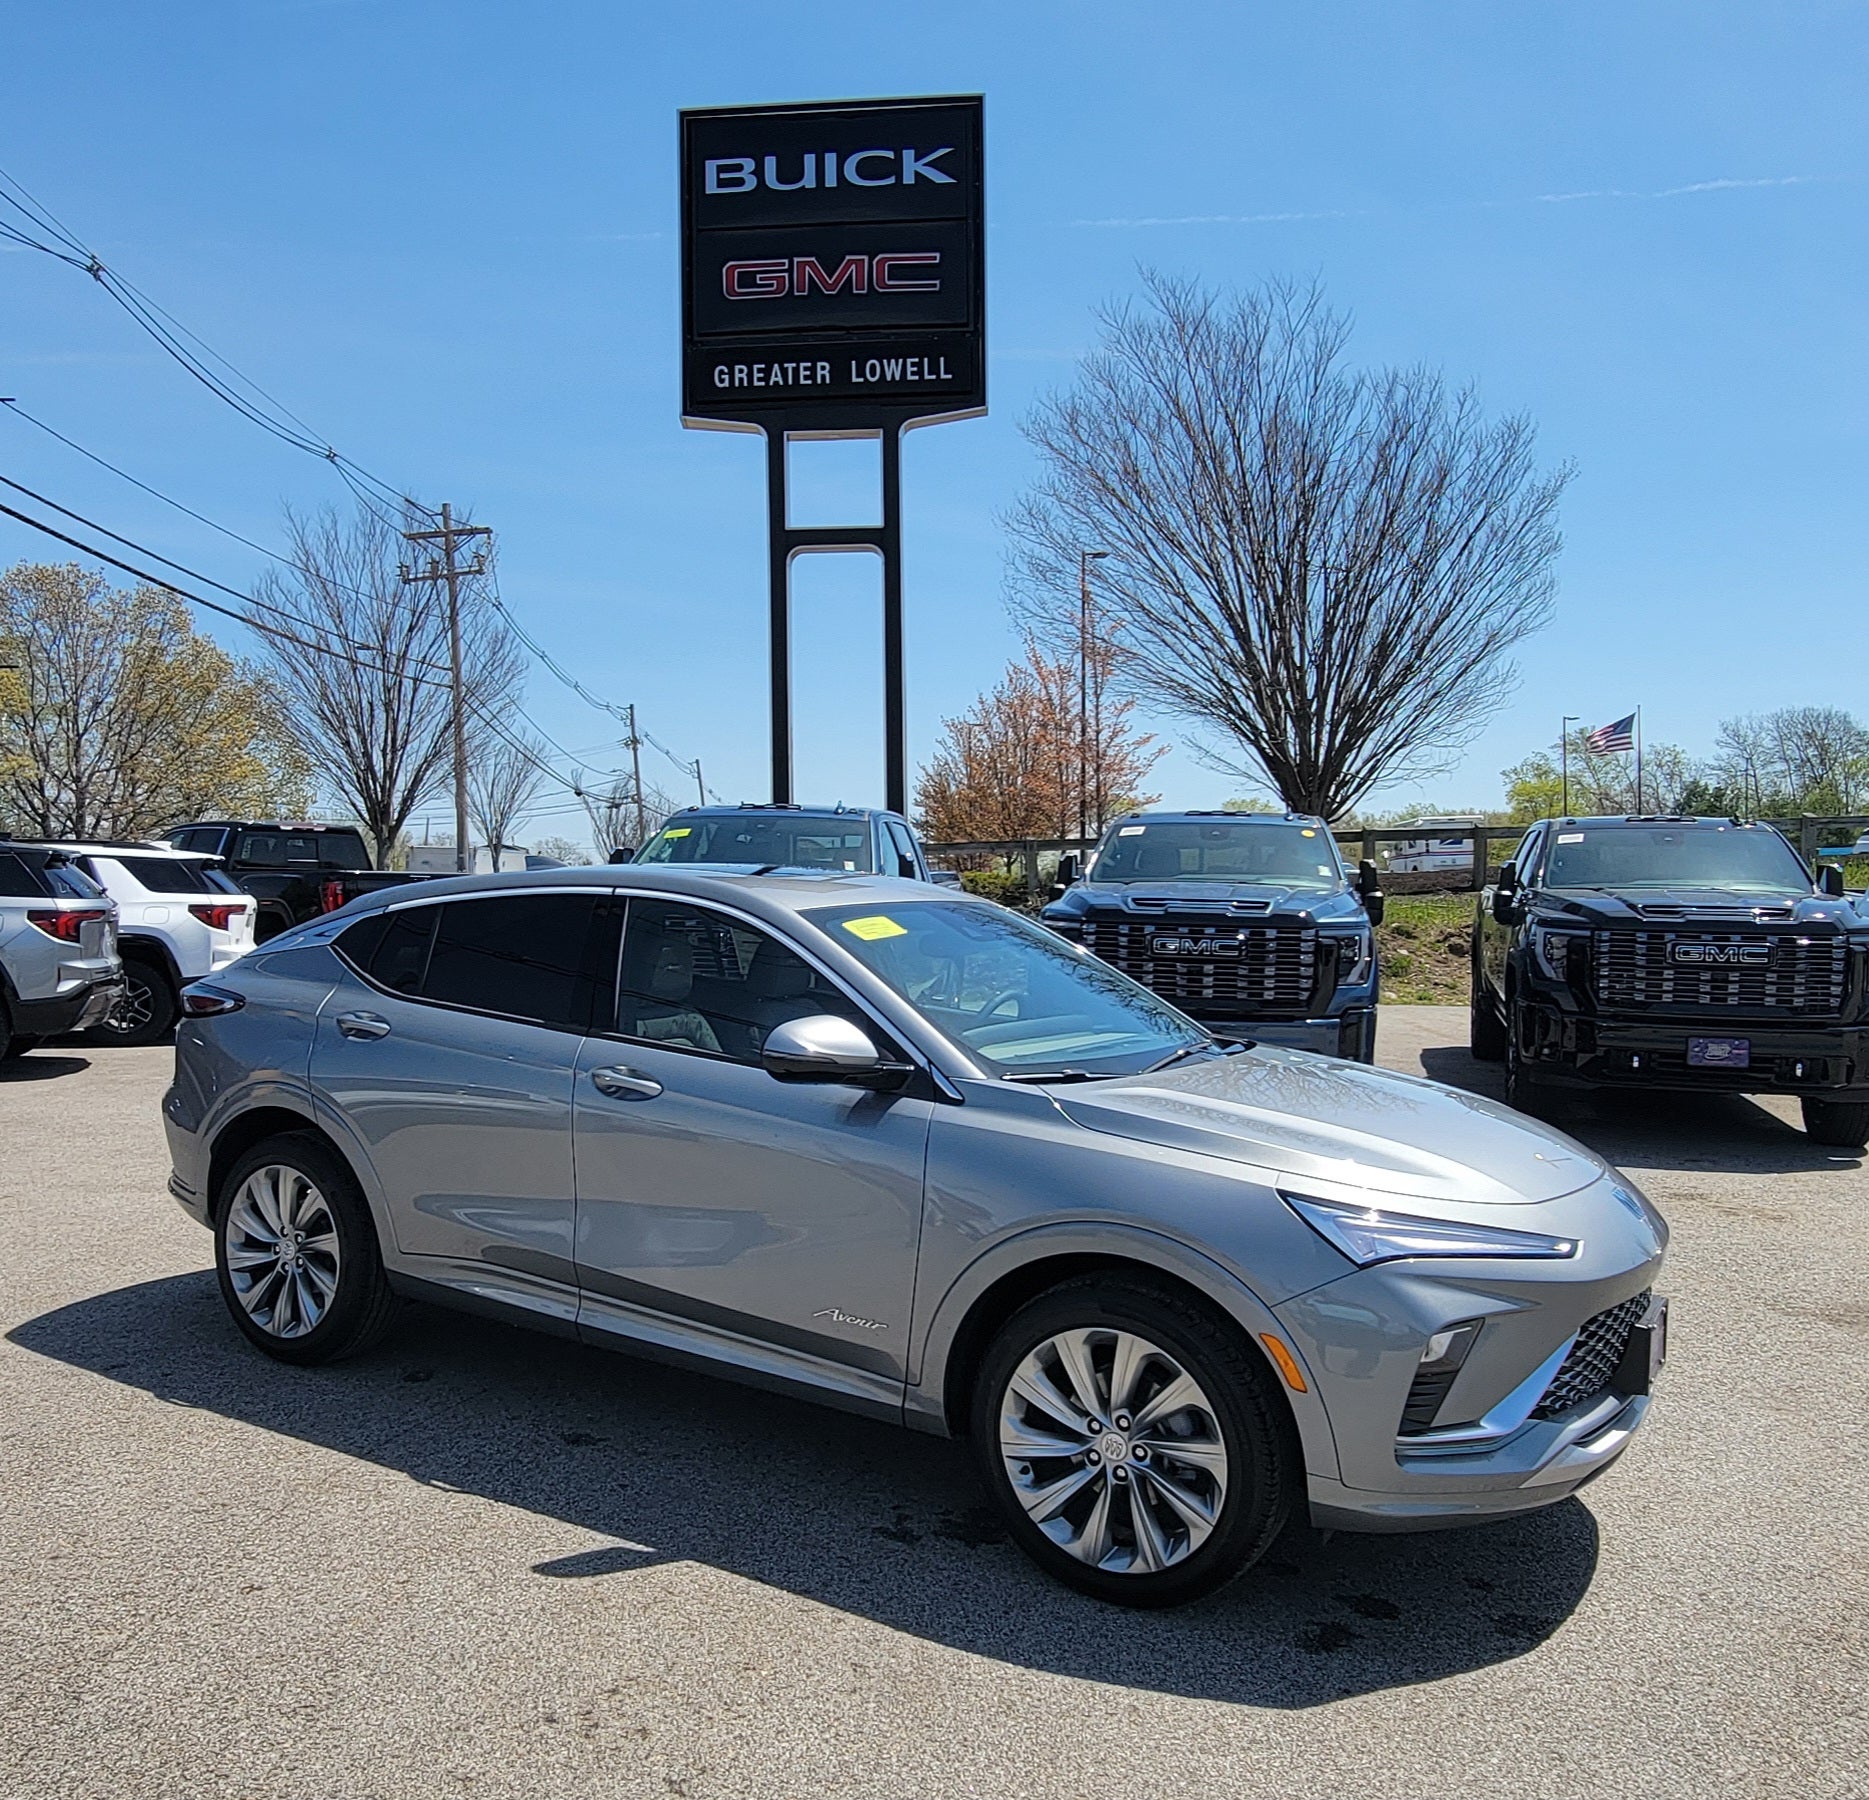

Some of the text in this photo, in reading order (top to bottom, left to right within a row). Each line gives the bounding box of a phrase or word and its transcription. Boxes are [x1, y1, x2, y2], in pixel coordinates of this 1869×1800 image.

[704, 147, 958, 195] BUICK
[722, 252, 941, 300] GMC
[713, 356, 953, 389] GREATER LOWELL
[1153, 937, 1239, 956] GMC
[1675, 945, 1769, 963] GMC
[812, 1307, 888, 1330] Avenir
